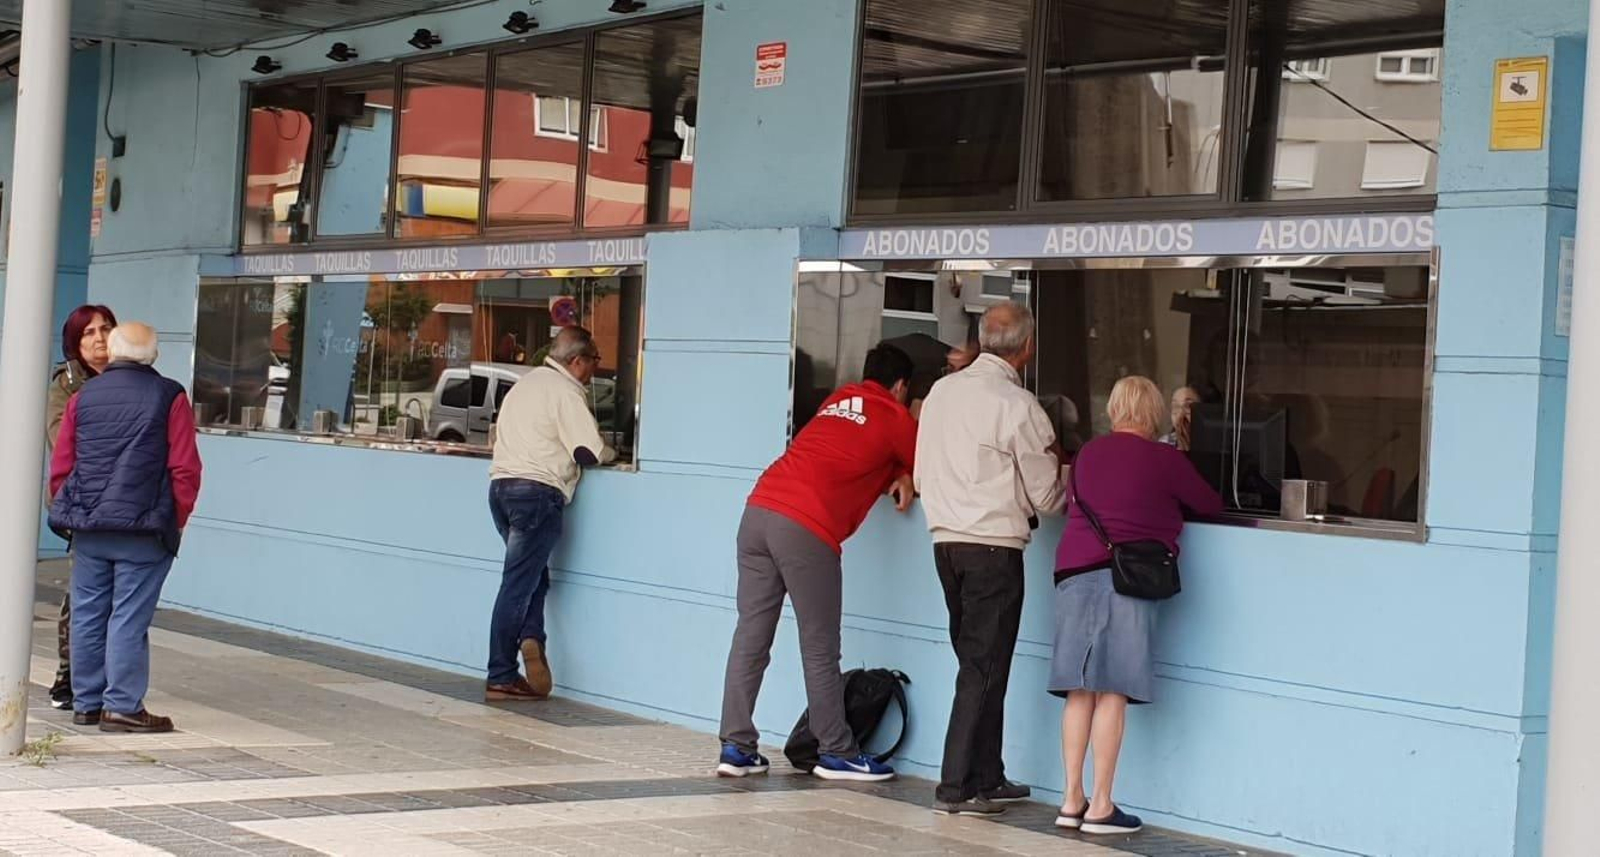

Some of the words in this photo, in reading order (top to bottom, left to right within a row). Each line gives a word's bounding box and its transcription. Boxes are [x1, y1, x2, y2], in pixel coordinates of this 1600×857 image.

[863, 229, 991, 256] ABONADOS
[1044, 222, 1194, 254] ABONADOS
[1257, 215, 1434, 250] ABONADOS
[243, 254, 295, 272] TAQUILLAS
[315, 251, 371, 272] TAQUILLAS
[395, 247, 459, 270] TAQUILLAS
[486, 243, 557, 266] TAQUILLAS
